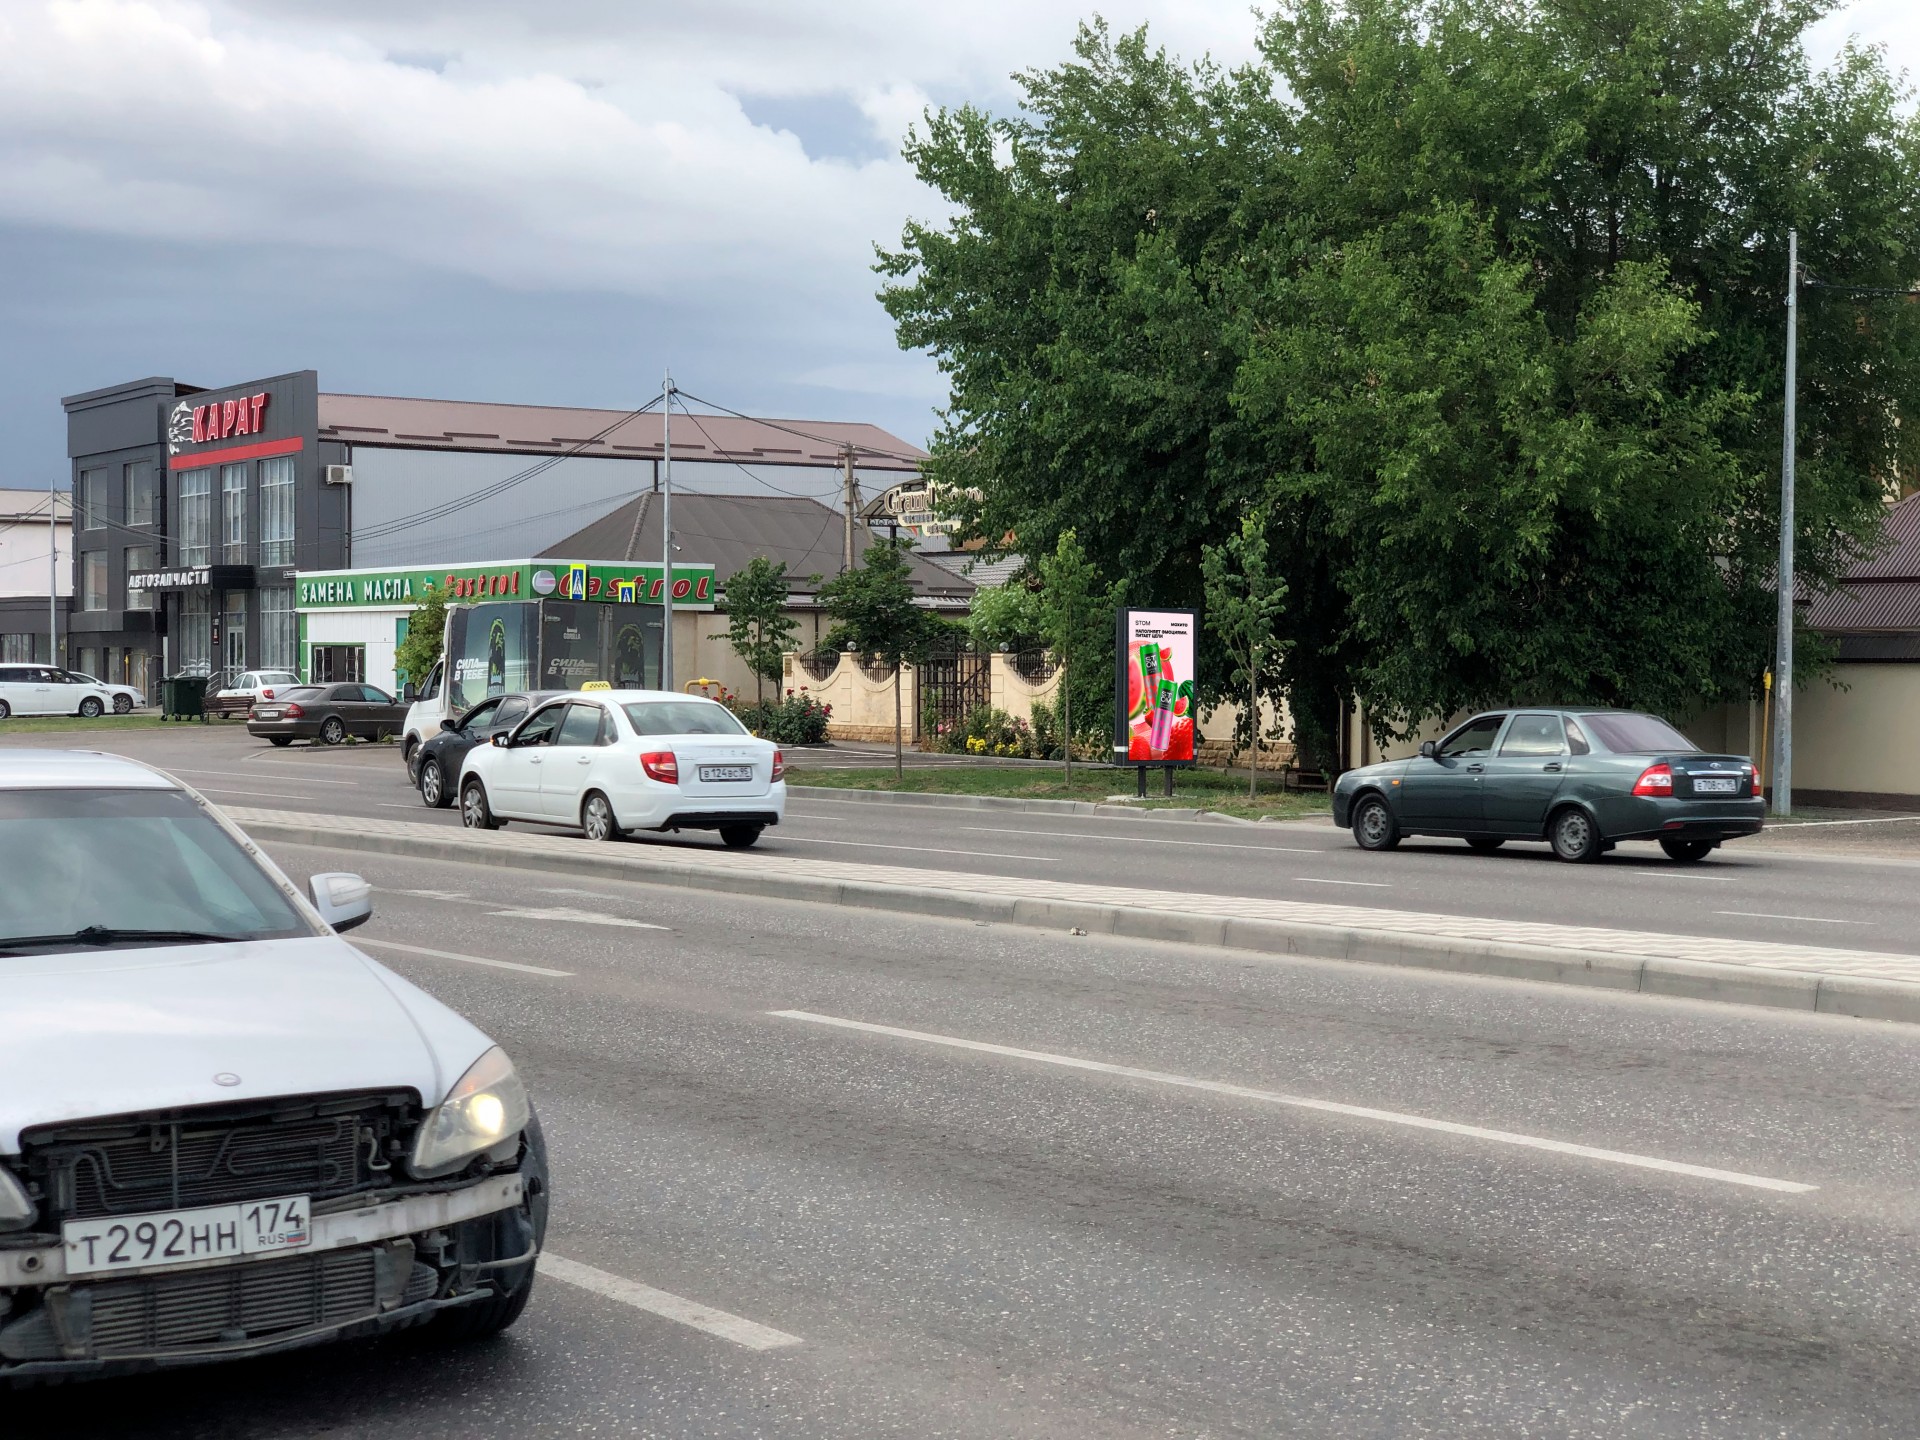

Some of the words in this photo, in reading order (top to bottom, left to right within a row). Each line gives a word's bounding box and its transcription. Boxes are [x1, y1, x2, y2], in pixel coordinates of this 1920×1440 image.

[192, 393, 267, 443] КАРАТ
[885, 488, 935, 514] Grand
[128, 571, 209, 588] АВТОЗАПЧАСТИ
[301, 582, 354, 602] ЗАМЕНА
[364, 578, 412, 599] МАСЛА
[456, 657, 480, 669] СИЛА
[551, 658, 585, 668] СИЛА
[454, 670, 461, 681] В
[463, 669, 484, 681] ТЕБЕ
[547, 667, 558, 675] В
[561, 667, 592, 676] ТЕБЕ
[247, 1201, 300, 1234] 174
[258, 1233, 285, 1246] RUS
